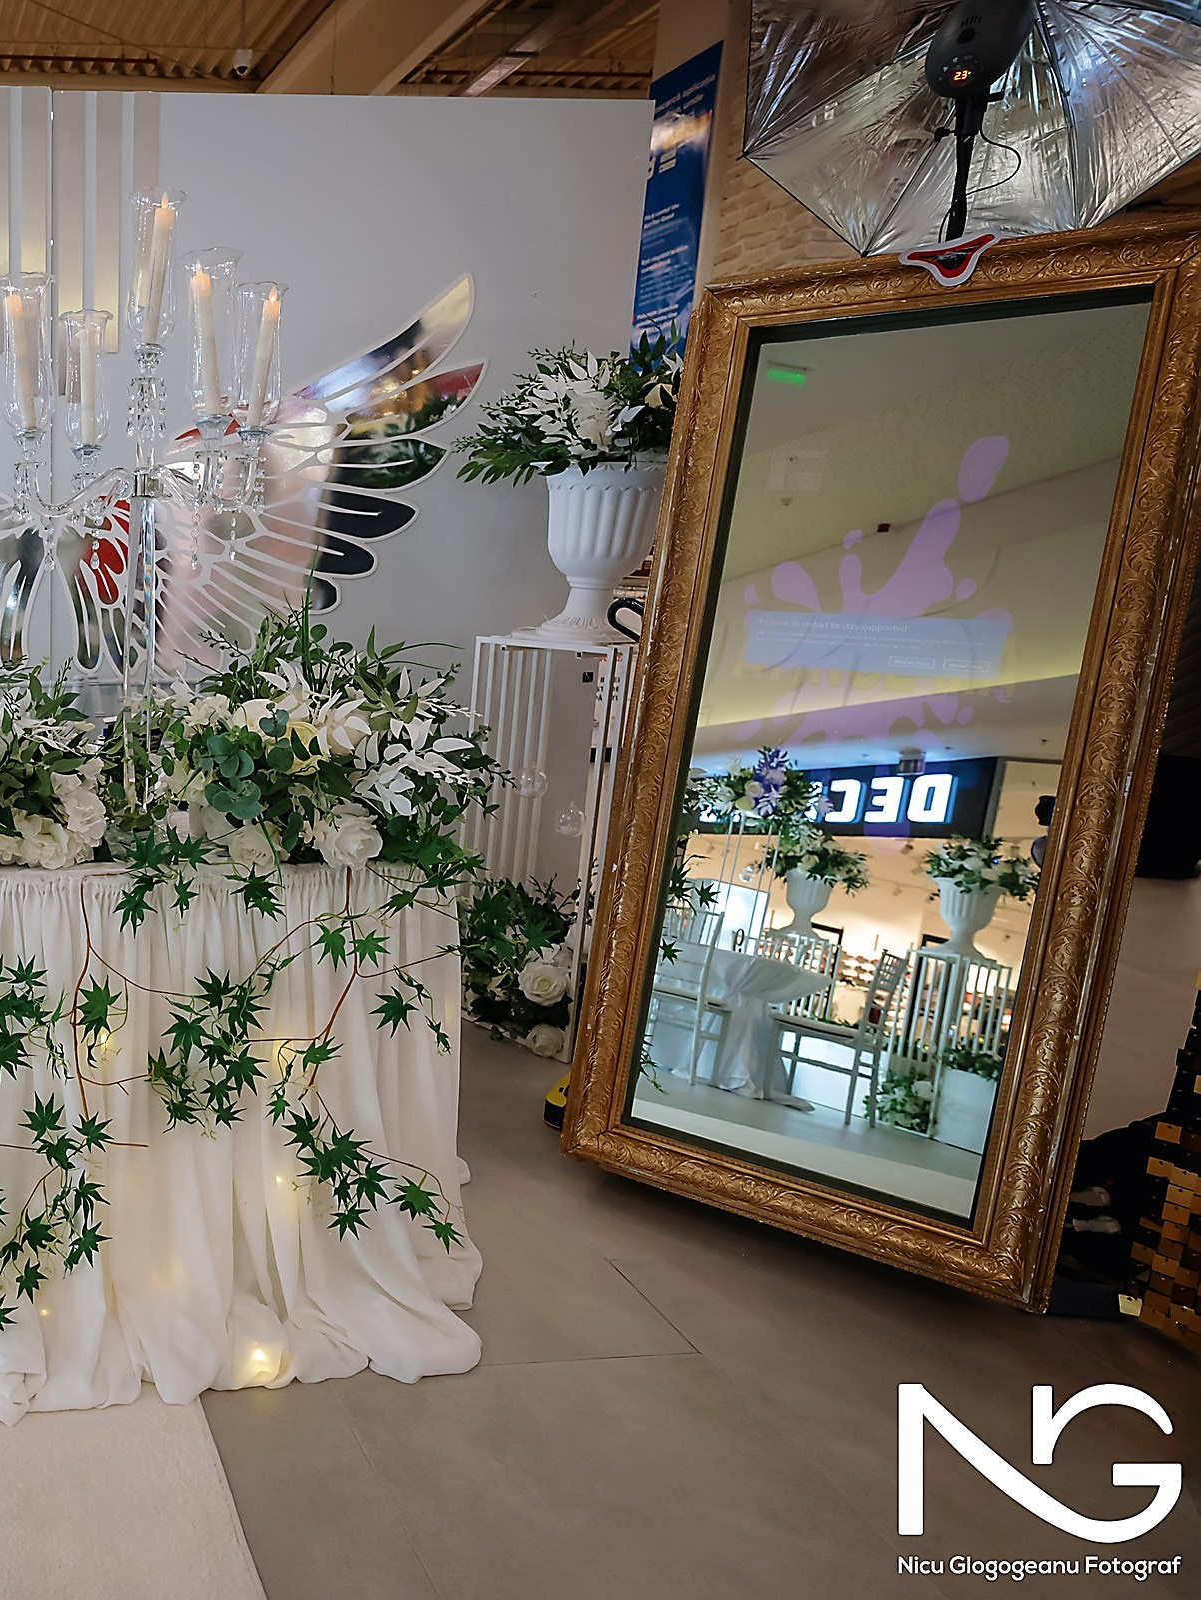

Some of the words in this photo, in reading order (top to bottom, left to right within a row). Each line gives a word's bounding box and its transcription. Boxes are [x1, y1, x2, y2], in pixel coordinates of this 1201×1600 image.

[801, 621, 829, 629] restart
[831, 622, 840, 630] to
[861, 624, 908, 634] supported
